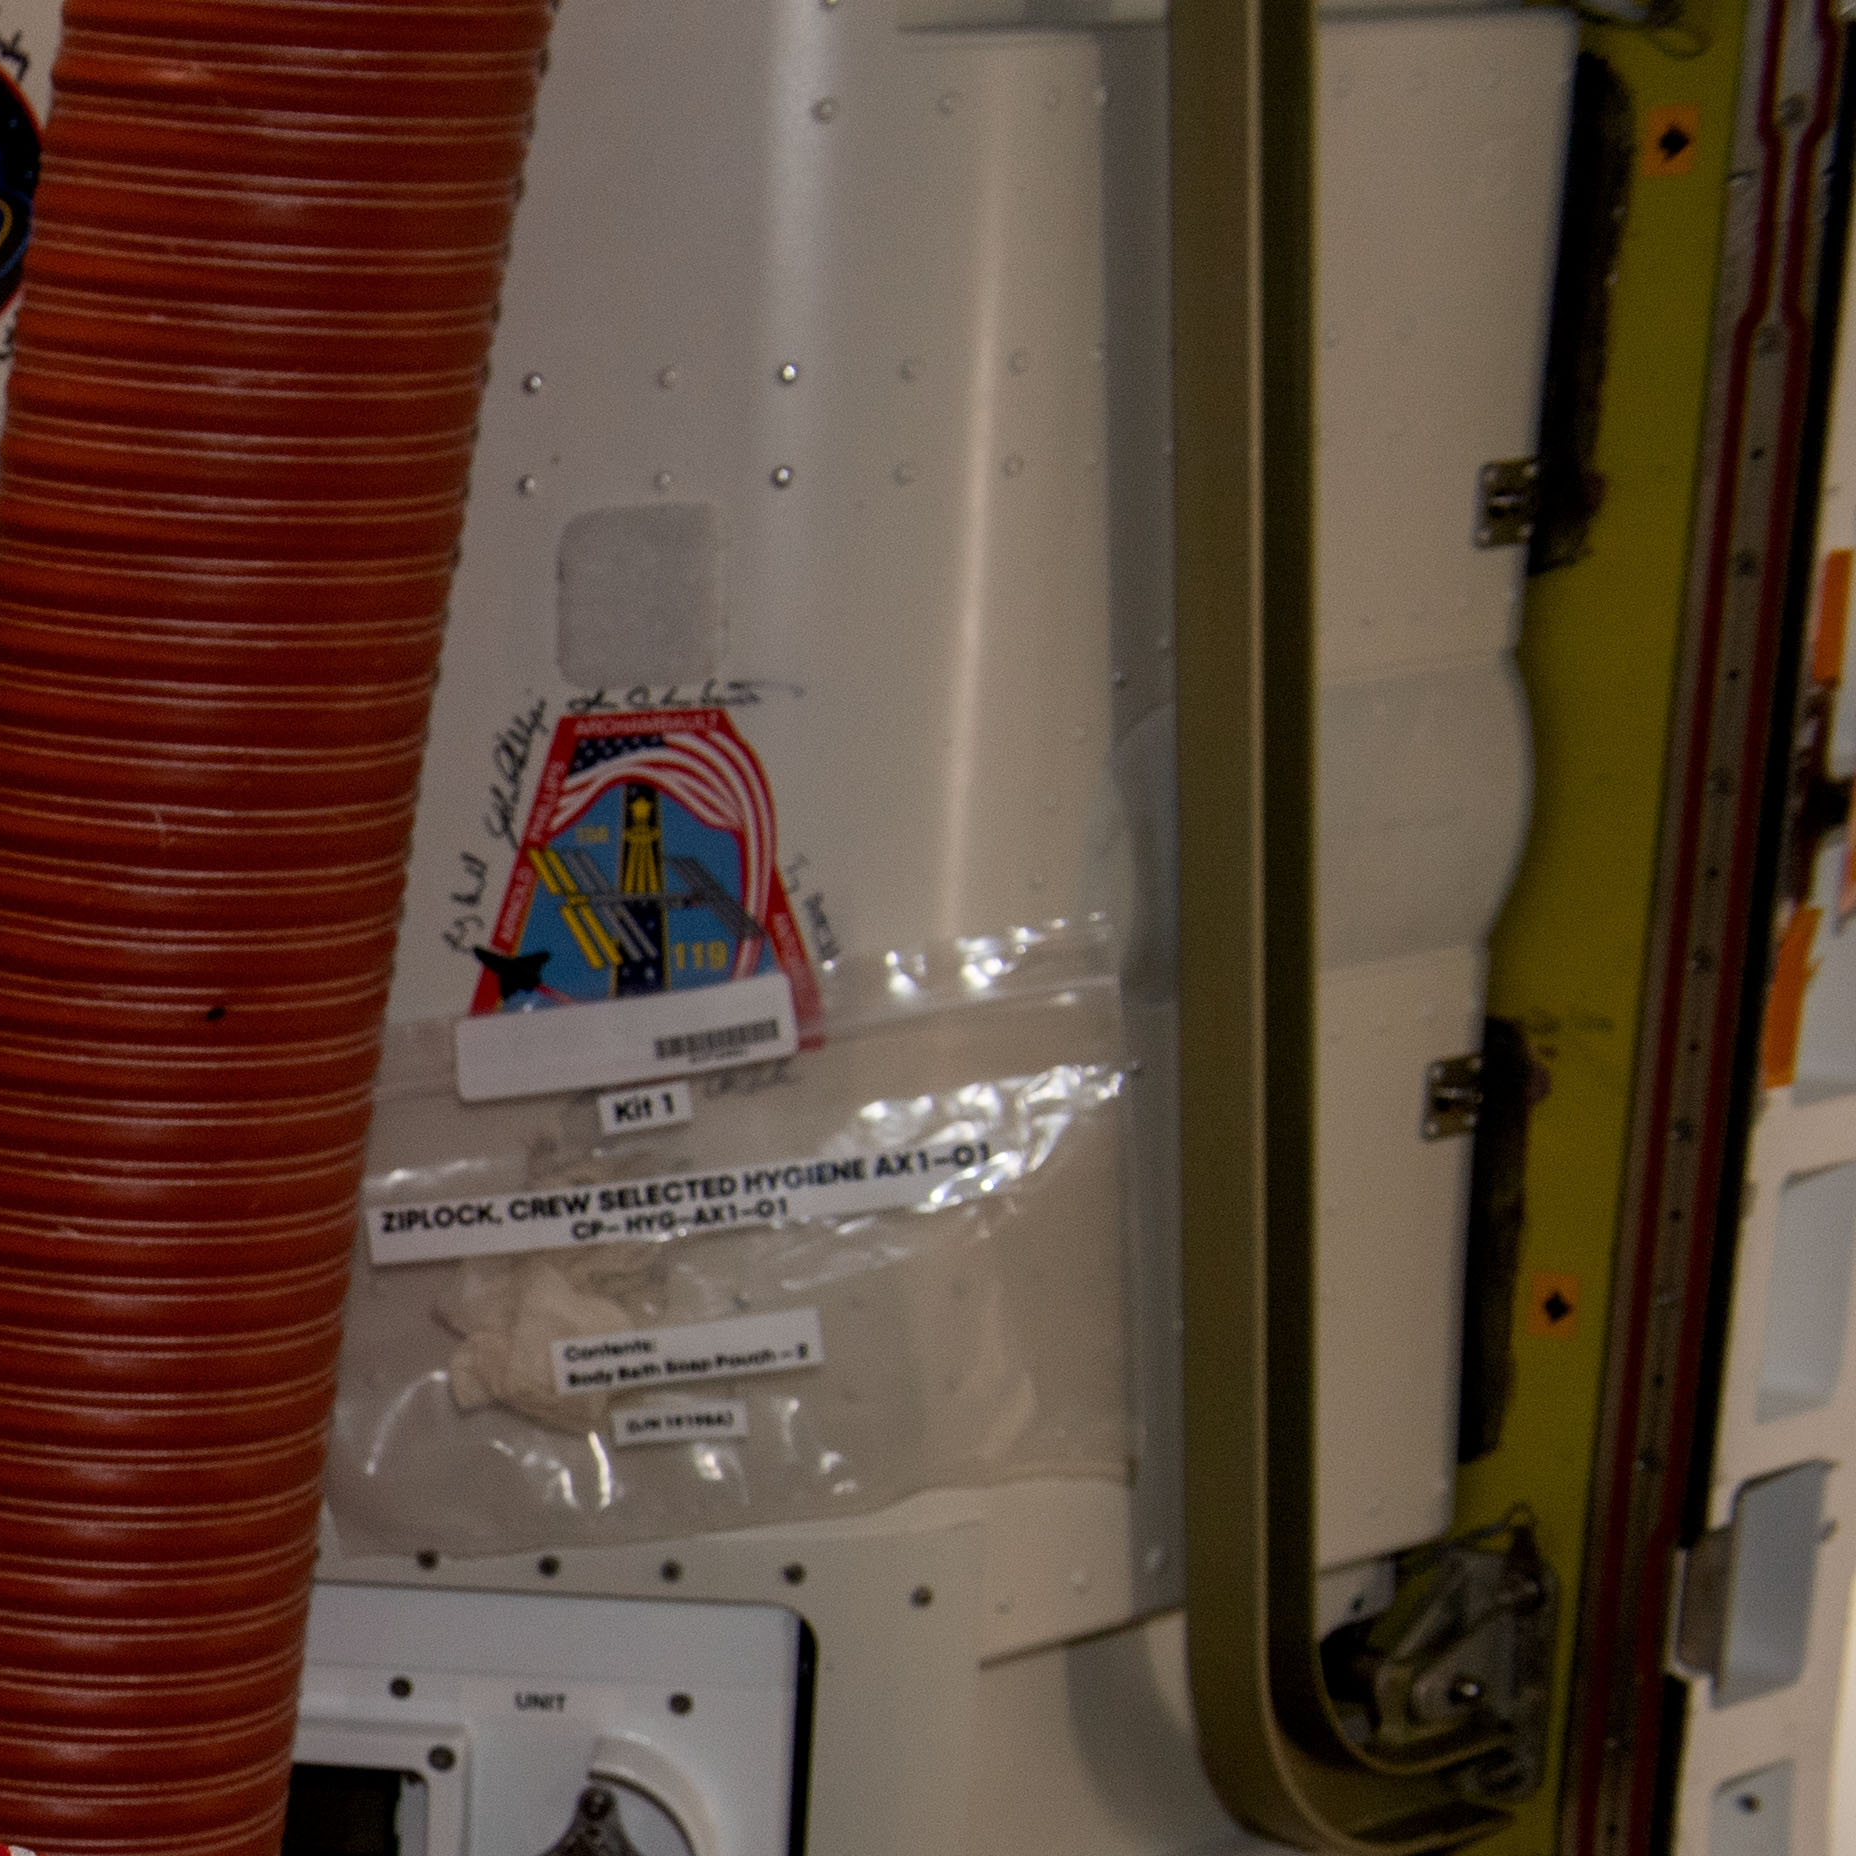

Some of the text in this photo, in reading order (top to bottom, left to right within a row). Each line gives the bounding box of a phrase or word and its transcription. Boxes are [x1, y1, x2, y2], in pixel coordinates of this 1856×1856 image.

[613, 1093, 675, 1124] Kit 1
[507, 1192, 591, 1222] CREW
[598, 1174, 737, 1213] SELECTED
[741, 1156, 866, 1195] HYGIENE
[514, 1690, 567, 1713] UNIT
